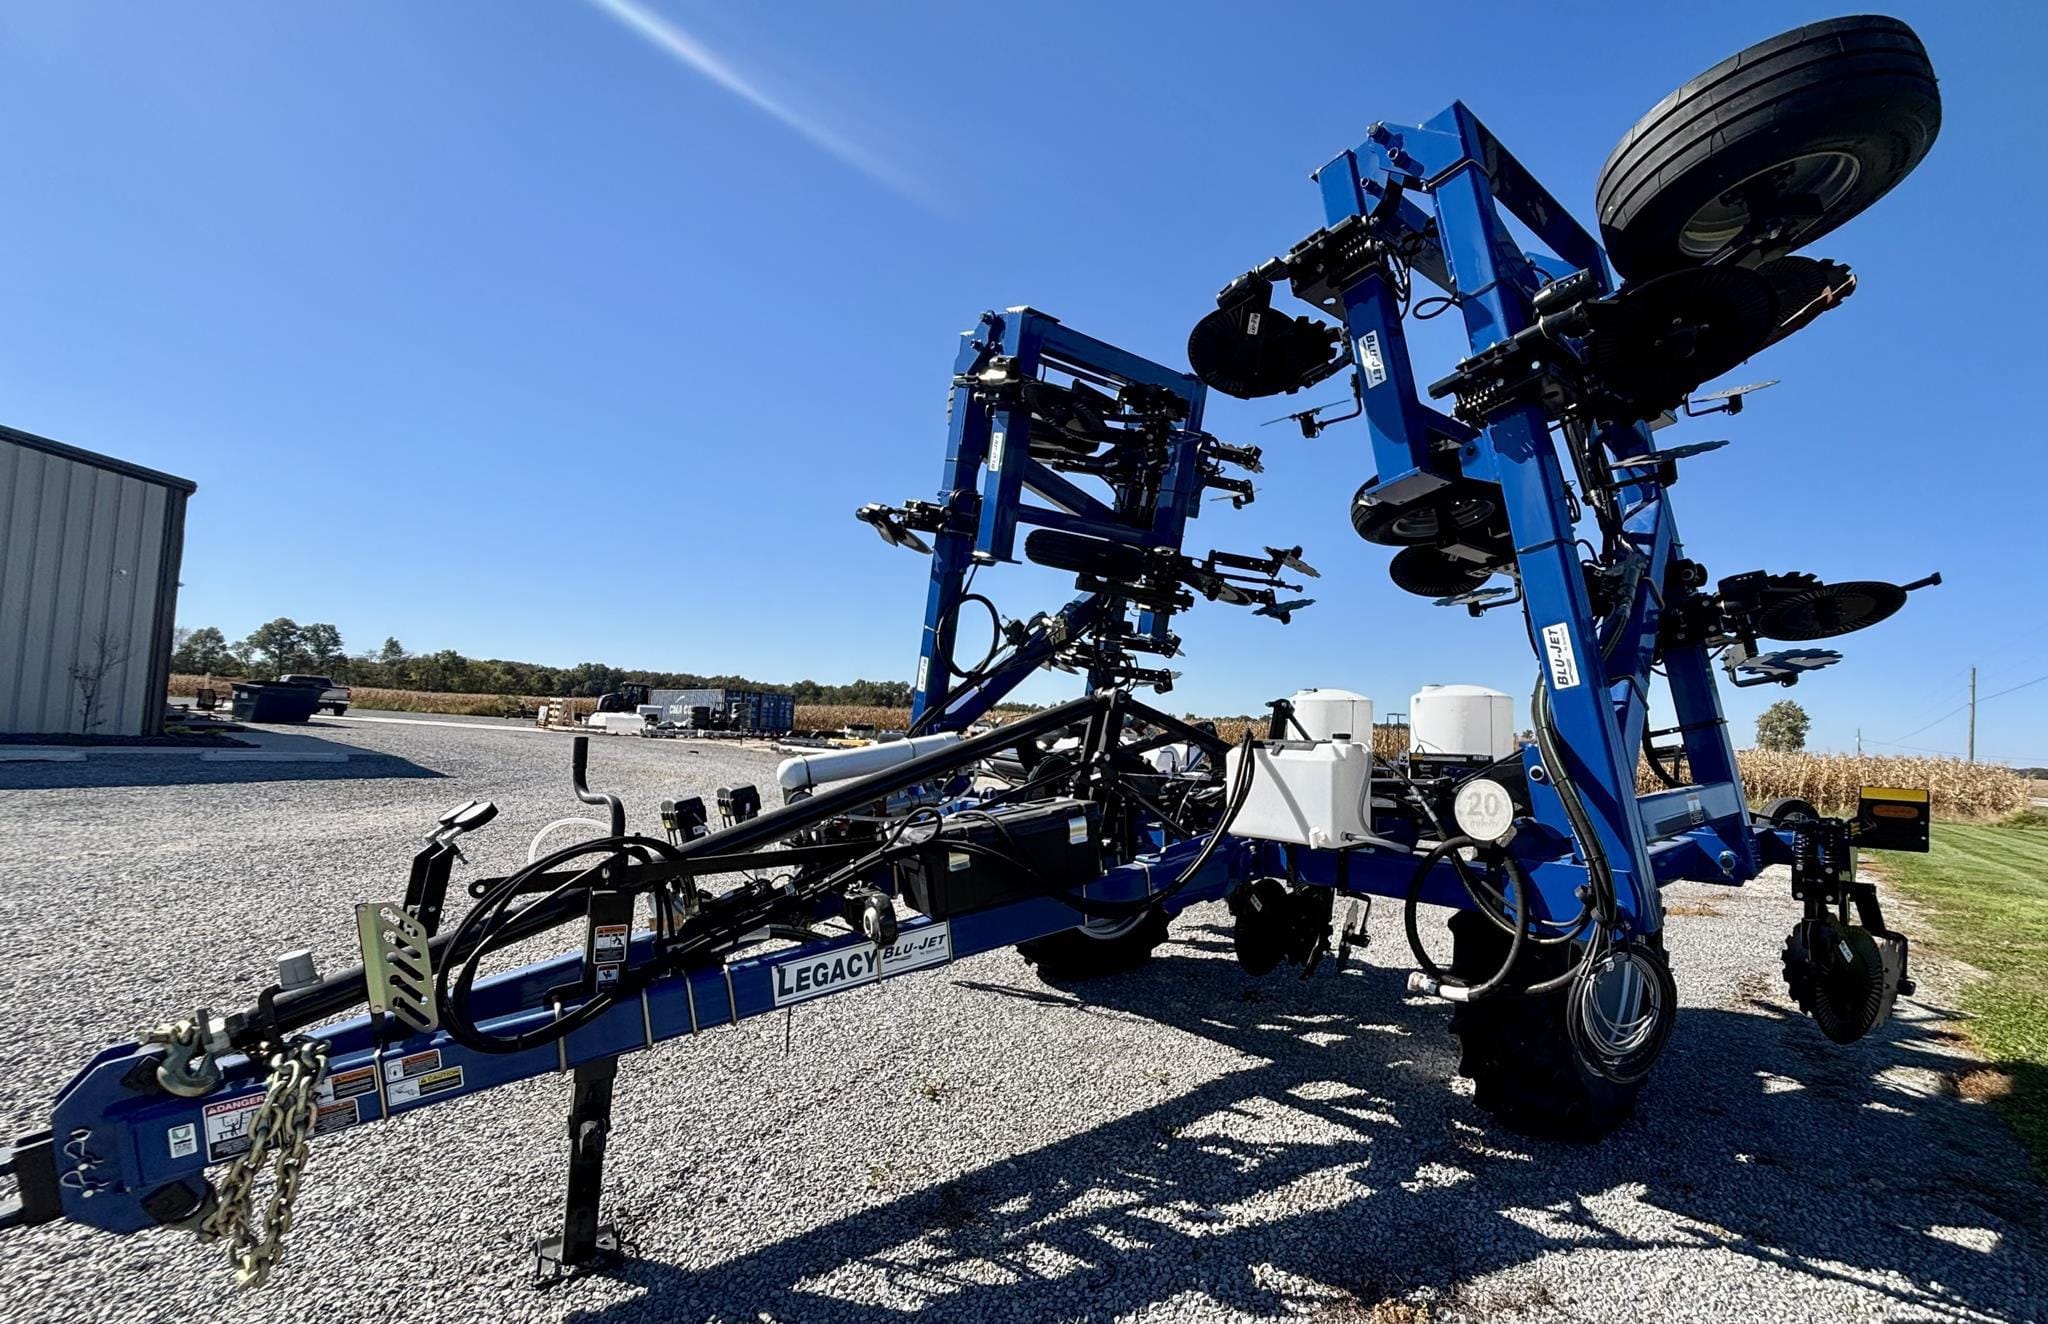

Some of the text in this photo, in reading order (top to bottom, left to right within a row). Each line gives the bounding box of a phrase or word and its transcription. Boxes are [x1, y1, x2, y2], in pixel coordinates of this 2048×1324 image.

[1366, 335, 1383, 380] BLU-JET
[1547, 628, 1569, 685] BLU-JET
[1467, 792, 1500, 817] 20
[778, 934, 946, 998] LEGACY BLU-JET
[216, 1095, 265, 1113] DANGER
